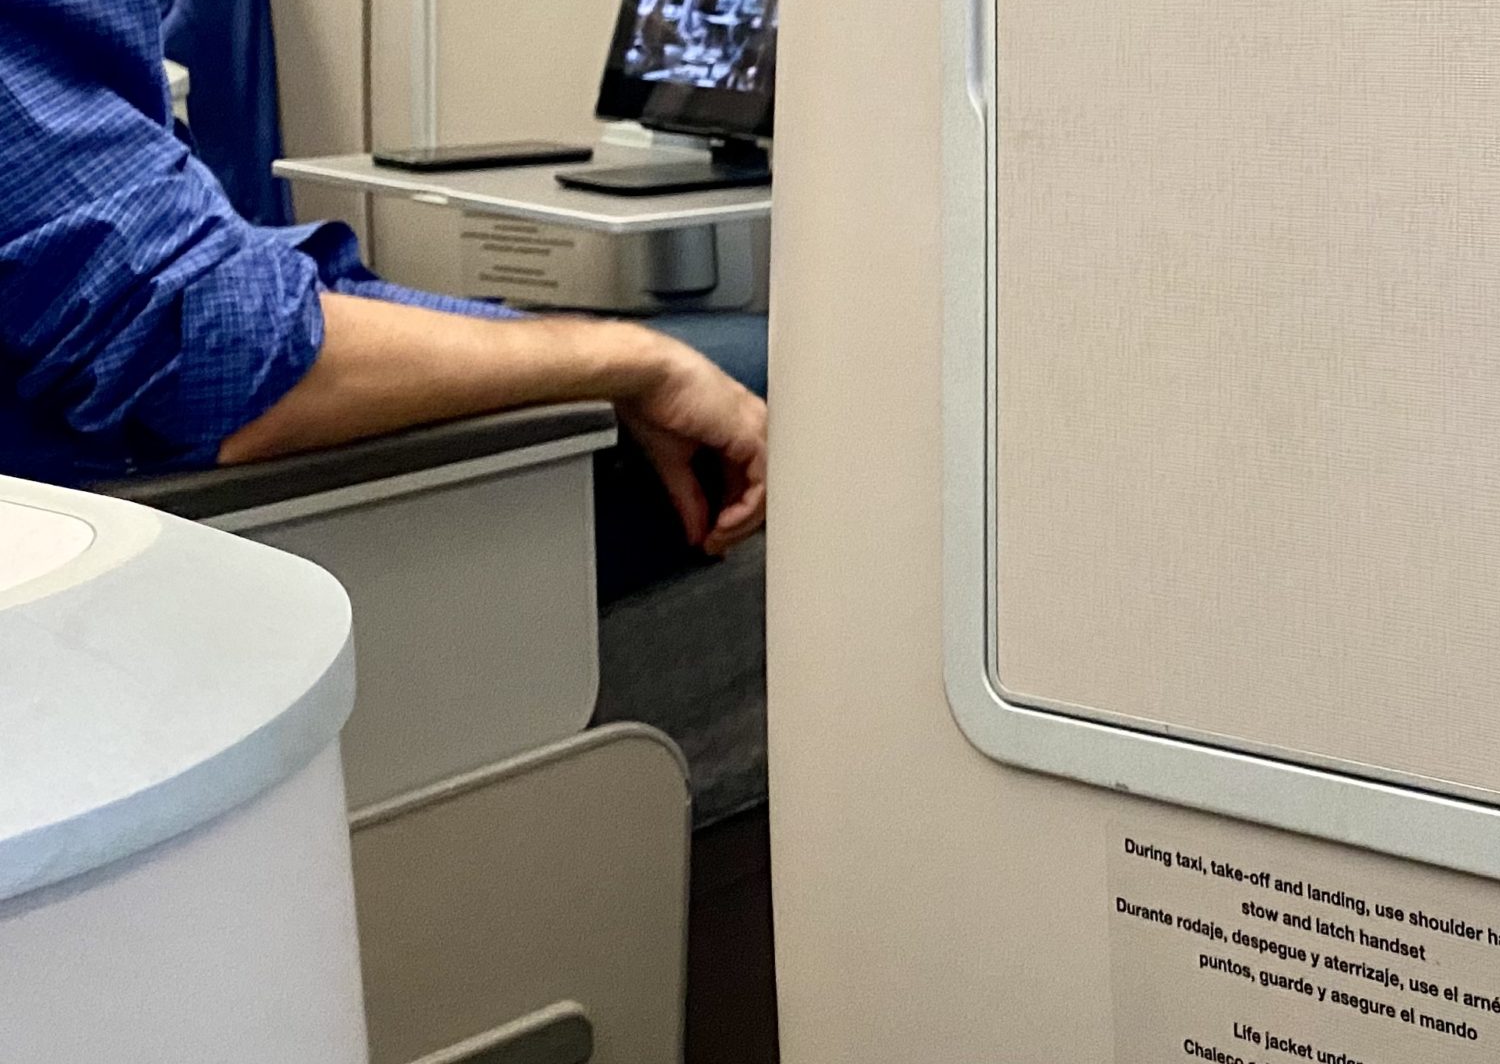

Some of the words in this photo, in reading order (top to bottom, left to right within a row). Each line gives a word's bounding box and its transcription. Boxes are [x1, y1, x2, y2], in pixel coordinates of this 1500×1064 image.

[1124, 837, 1172, 867] During
[1176, 851, 1208, 876] taxi,
[1211, 860, 1271, 888] take-off
[1274, 878, 1303, 896] and
[1307, 884, 1370, 916] landing,
[1375, 903, 1405, 922] use
[1409, 910, 1483, 941] shoulder
[1241, 901, 1279, 922] stow
[1282, 913, 1312, 931] and
[1316, 918, 1355, 943] latch
[1359, 929, 1426, 961] handset
[1116, 897, 1173, 925] Durante
[1176, 915, 1228, 944] rodaje,
[1232, 929, 1307, 961] despegue
[1310, 952, 1320, 968] y
[1324, 955, 1404, 991] aterrizaje,
[1409, 978, 1439, 997] use
[1443, 986, 1458, 1003] el
[1199, 954, 1255, 982] puntos,
[1259, 970, 1313, 995] guarde
[1316, 986, 1326, 1002] y
[1331, 989, 1396, 1019] asegure
[1400, 1008, 1415, 1024] el
[1420, 1012, 1478, 1041] mando
[1233, 1022, 1261, 1045] Life
[1265, 1031, 1313, 1060] jacket
[1317, 1050, 1363, 1064] und
